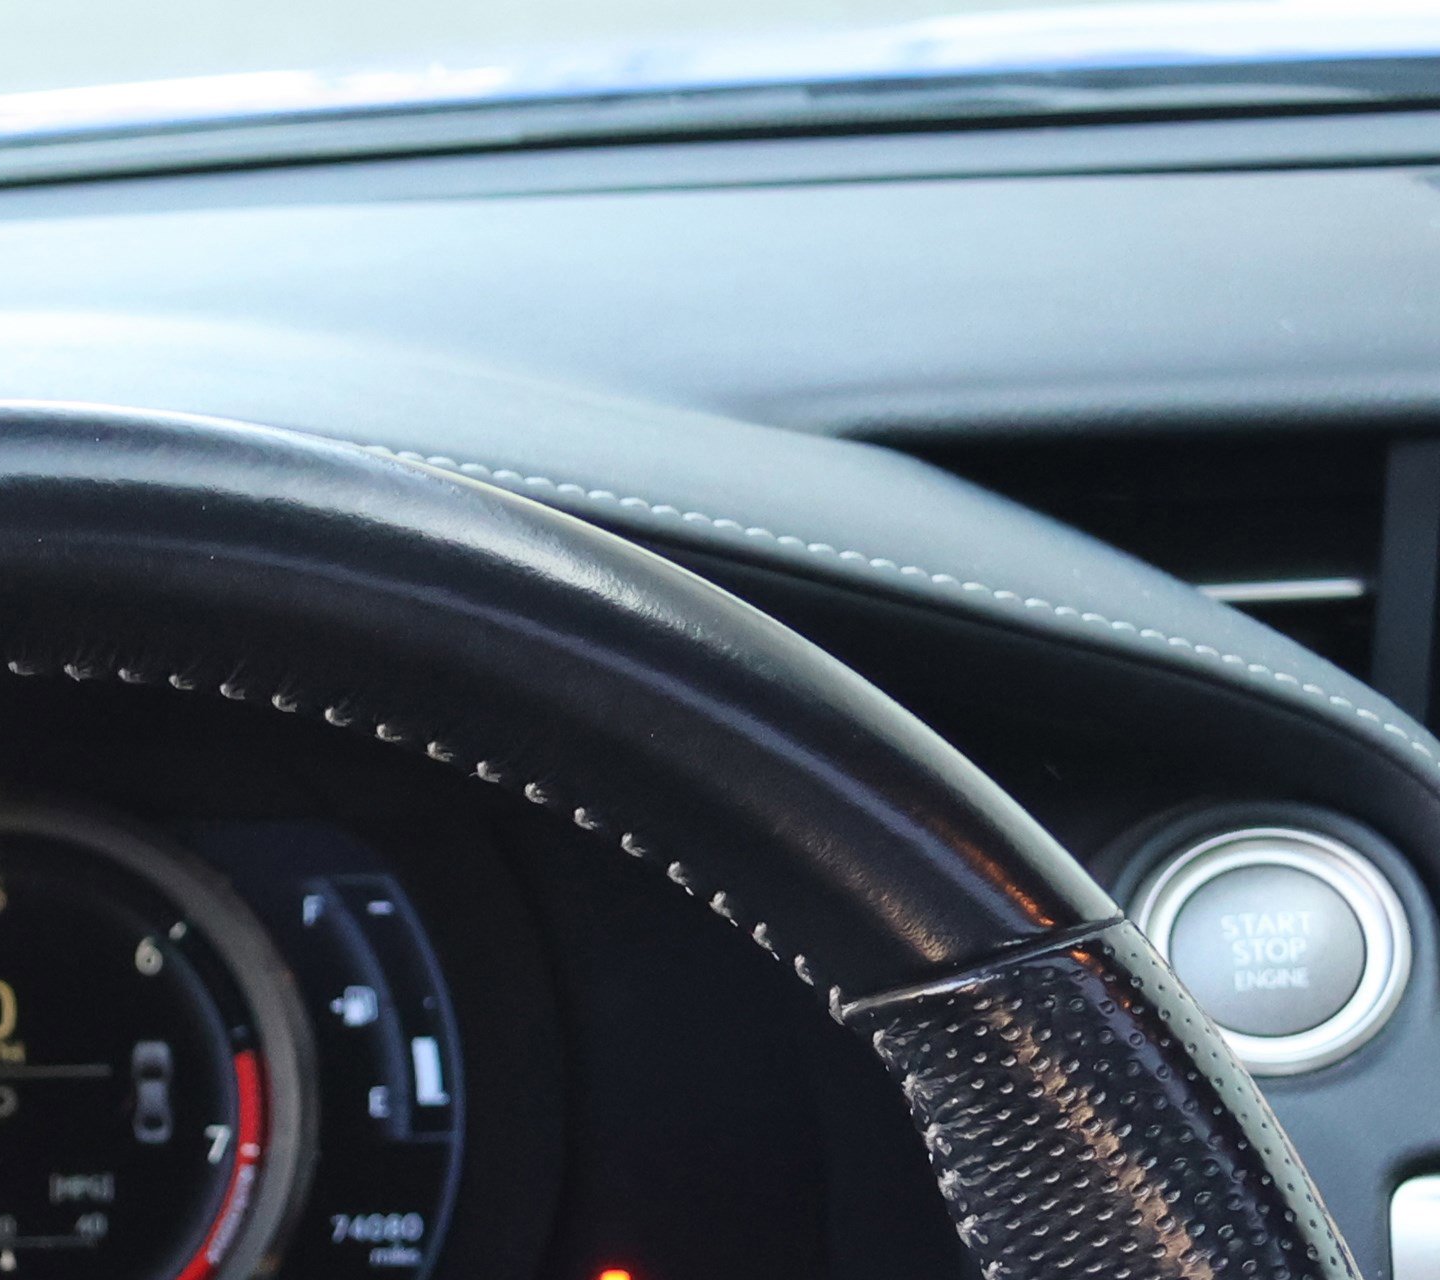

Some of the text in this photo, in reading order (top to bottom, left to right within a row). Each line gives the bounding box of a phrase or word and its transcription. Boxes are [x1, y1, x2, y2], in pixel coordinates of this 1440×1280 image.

[1220, 911, 1315, 937] START
[134, 936, 164, 976] 6
[1231, 936, 1308, 966] STOP
[1234, 966, 1310, 991] ENGINE
[204, 1124, 231, 1164] 7
